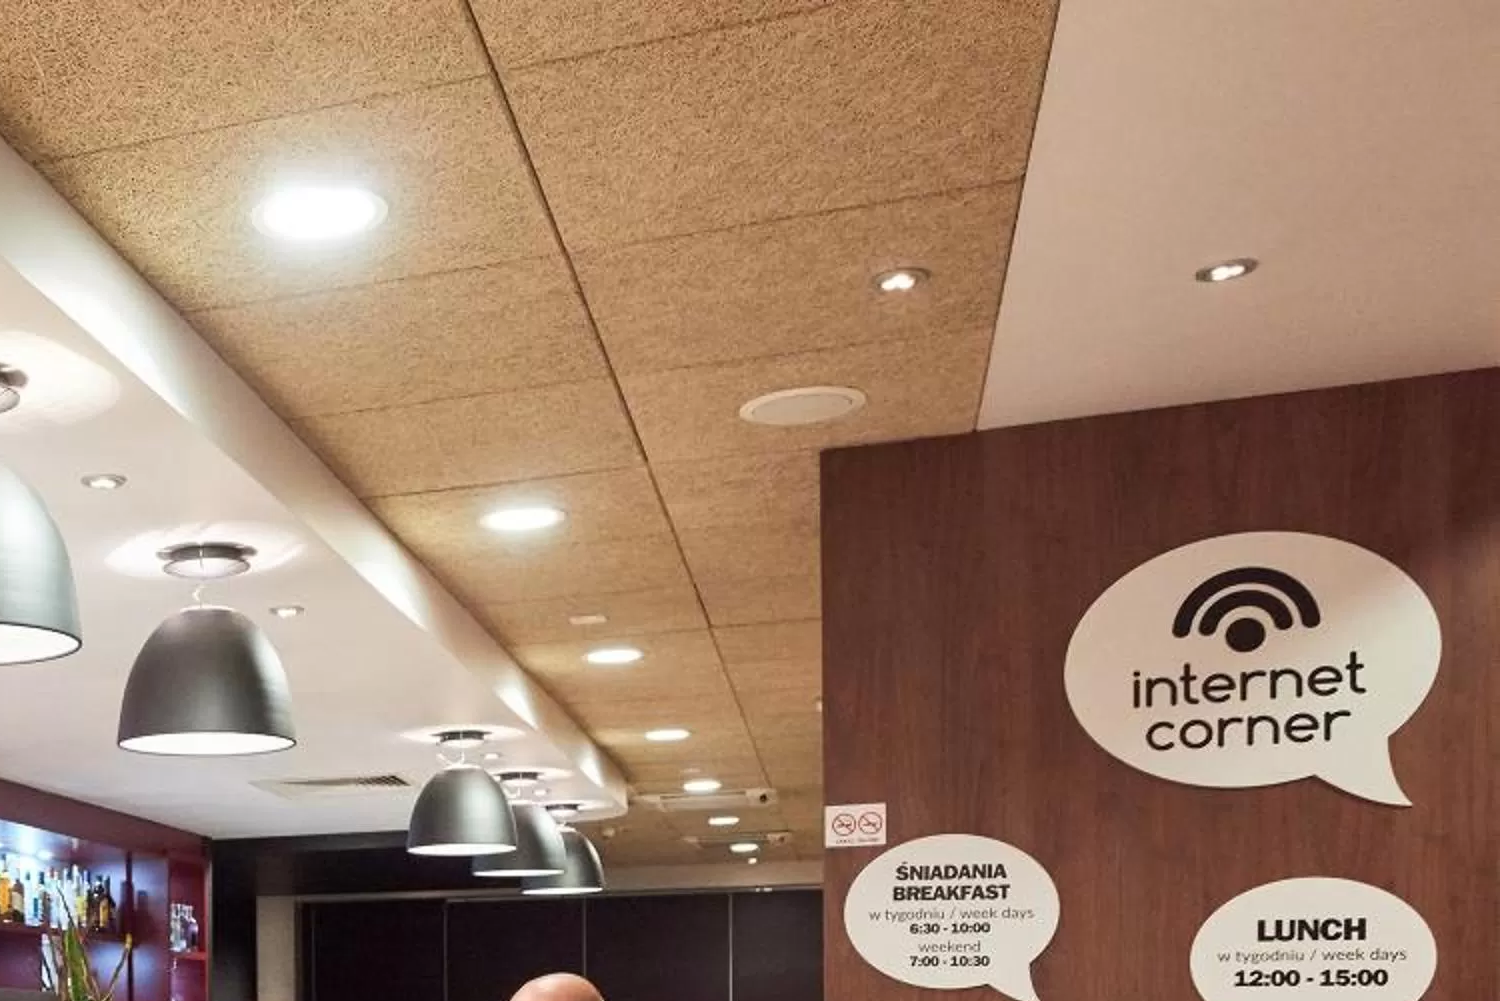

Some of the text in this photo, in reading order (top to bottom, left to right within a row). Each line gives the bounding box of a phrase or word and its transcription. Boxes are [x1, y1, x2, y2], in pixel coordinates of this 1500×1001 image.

[1132, 650, 1367, 709] internet
[1145, 709, 1351, 751] corner
[895, 861, 1008, 881] ŚNIADANIA
[892, 883, 1011, 902] BREAKFAST
[868, 911, 881, 921] w
[884, 907, 945, 923] tygodniu
[959, 907, 998, 920] week
[1001, 906, 1036, 921] days
[909, 922, 941, 935] 6:30
[951, 921, 991, 934] 10:00
[1257, 917, 1367, 942] LUNCH
[918, 939, 981, 953] weekend
[1217, 953, 1231, 963] w
[1235, 950, 1305, 965] tygodniu
[1321, 948, 1365, 962] week
[1369, 946, 1407, 963] days
[909, 955, 940, 967] 7:00
[950, 955, 991, 967] 10:30
[1234, 969, 1301, 987] 12:00
[1319, 968, 1389, 987] 15:00
